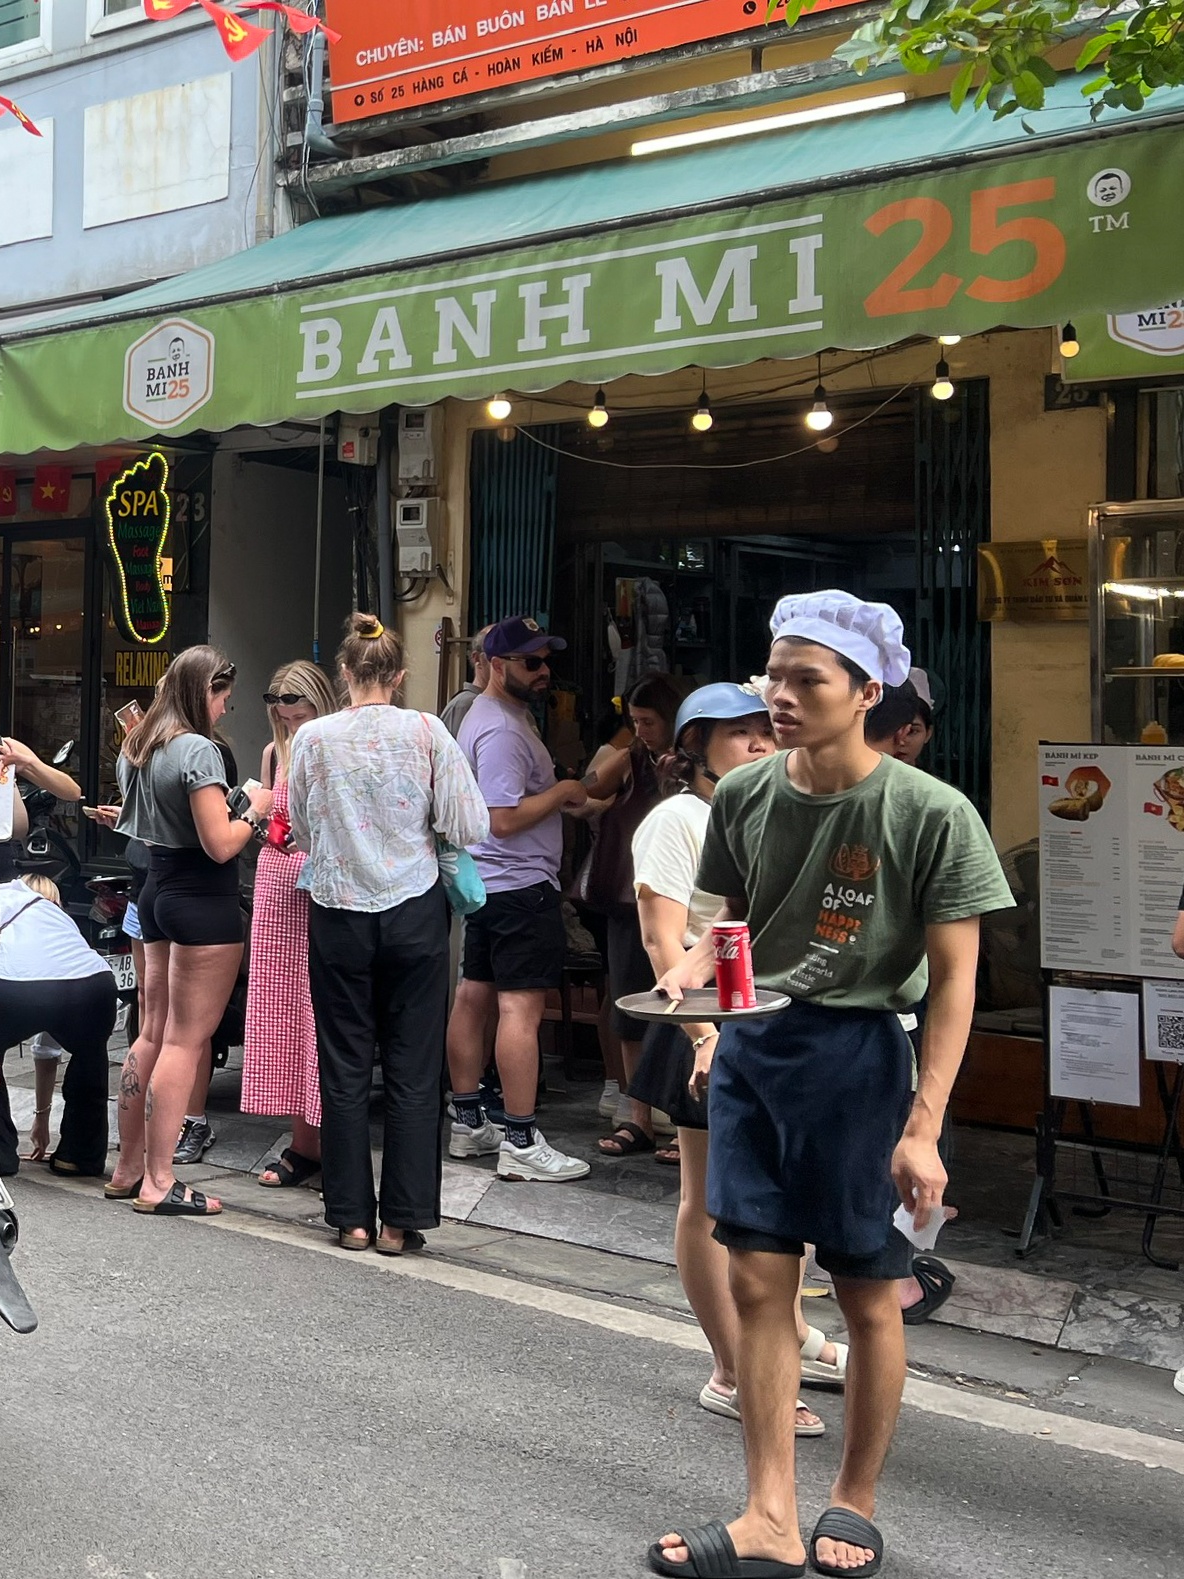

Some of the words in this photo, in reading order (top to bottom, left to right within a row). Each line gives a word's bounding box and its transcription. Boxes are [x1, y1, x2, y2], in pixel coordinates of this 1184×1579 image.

[356, 37, 424, 66] CHUYÊN:
[432, 23, 467, 48] BÁN
[477, 10, 525, 38] BUÔN
[391, 86, 405, 99] 25
[413, 75, 444, 95] HÀNG
[453, 66, 468, 85] CÁ
[487, 57, 521, 77] HOÀN
[532, 46, 564, 66] KIẾM
[585, 34, 604, 54] HÀ
[615, 26, 638, 48] NỘI
[1089, 210, 1130, 234] TM
[296, 272, 590, 383] BANH
[654, 232, 824, 334] MI
[863, 176, 1067, 318] 25
[1137, 310, 1184, 330] MI2
[146, 360, 190, 382] BANH
[118, 489, 159, 518] SPA
[175, 491, 205, 522] 23
[125, 561, 156, 577] Massag
[822, 896, 842, 910] OF
[823, 882, 834, 895] A
[837, 886, 876, 907] LOAF
